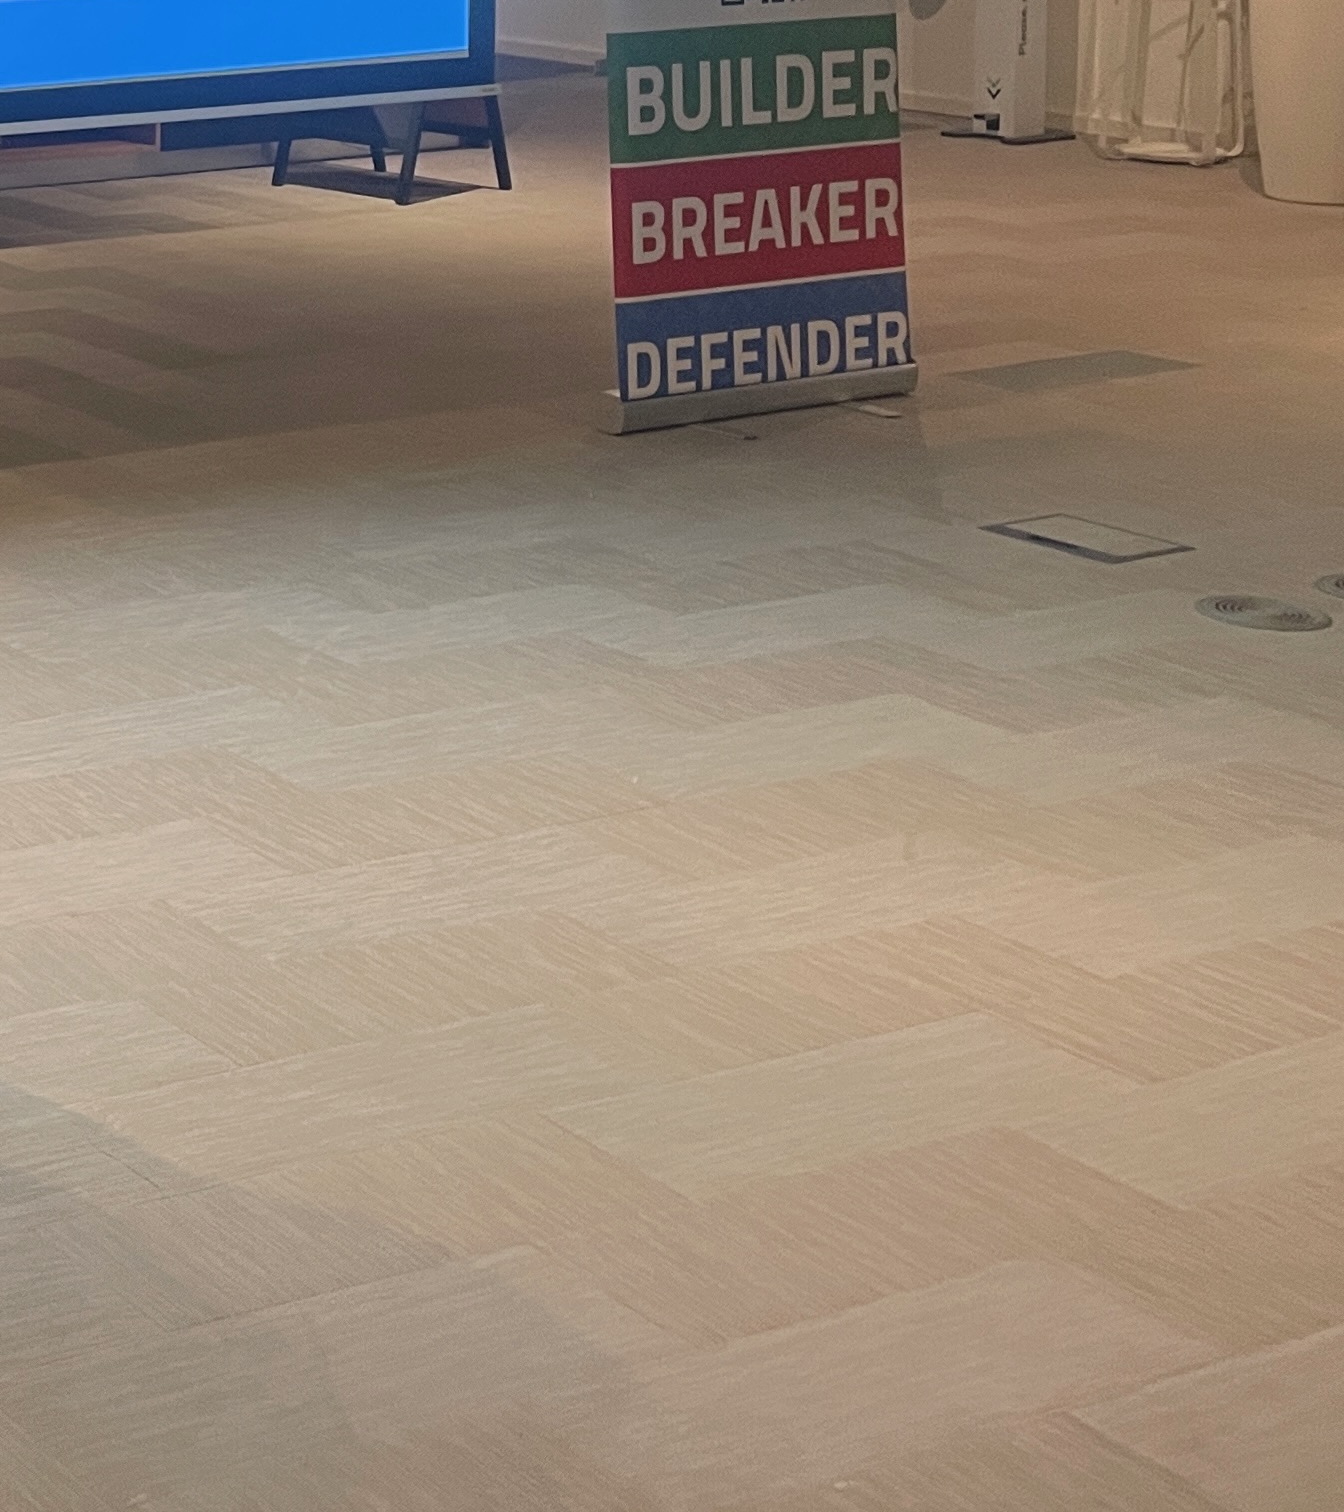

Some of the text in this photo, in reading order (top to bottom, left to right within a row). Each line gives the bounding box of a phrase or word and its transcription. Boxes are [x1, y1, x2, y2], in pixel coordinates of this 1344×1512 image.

[625, 46, 899, 137] BUILDER
[630, 176, 900, 266] BREAKER
[625, 309, 910, 401] DEFENDER
